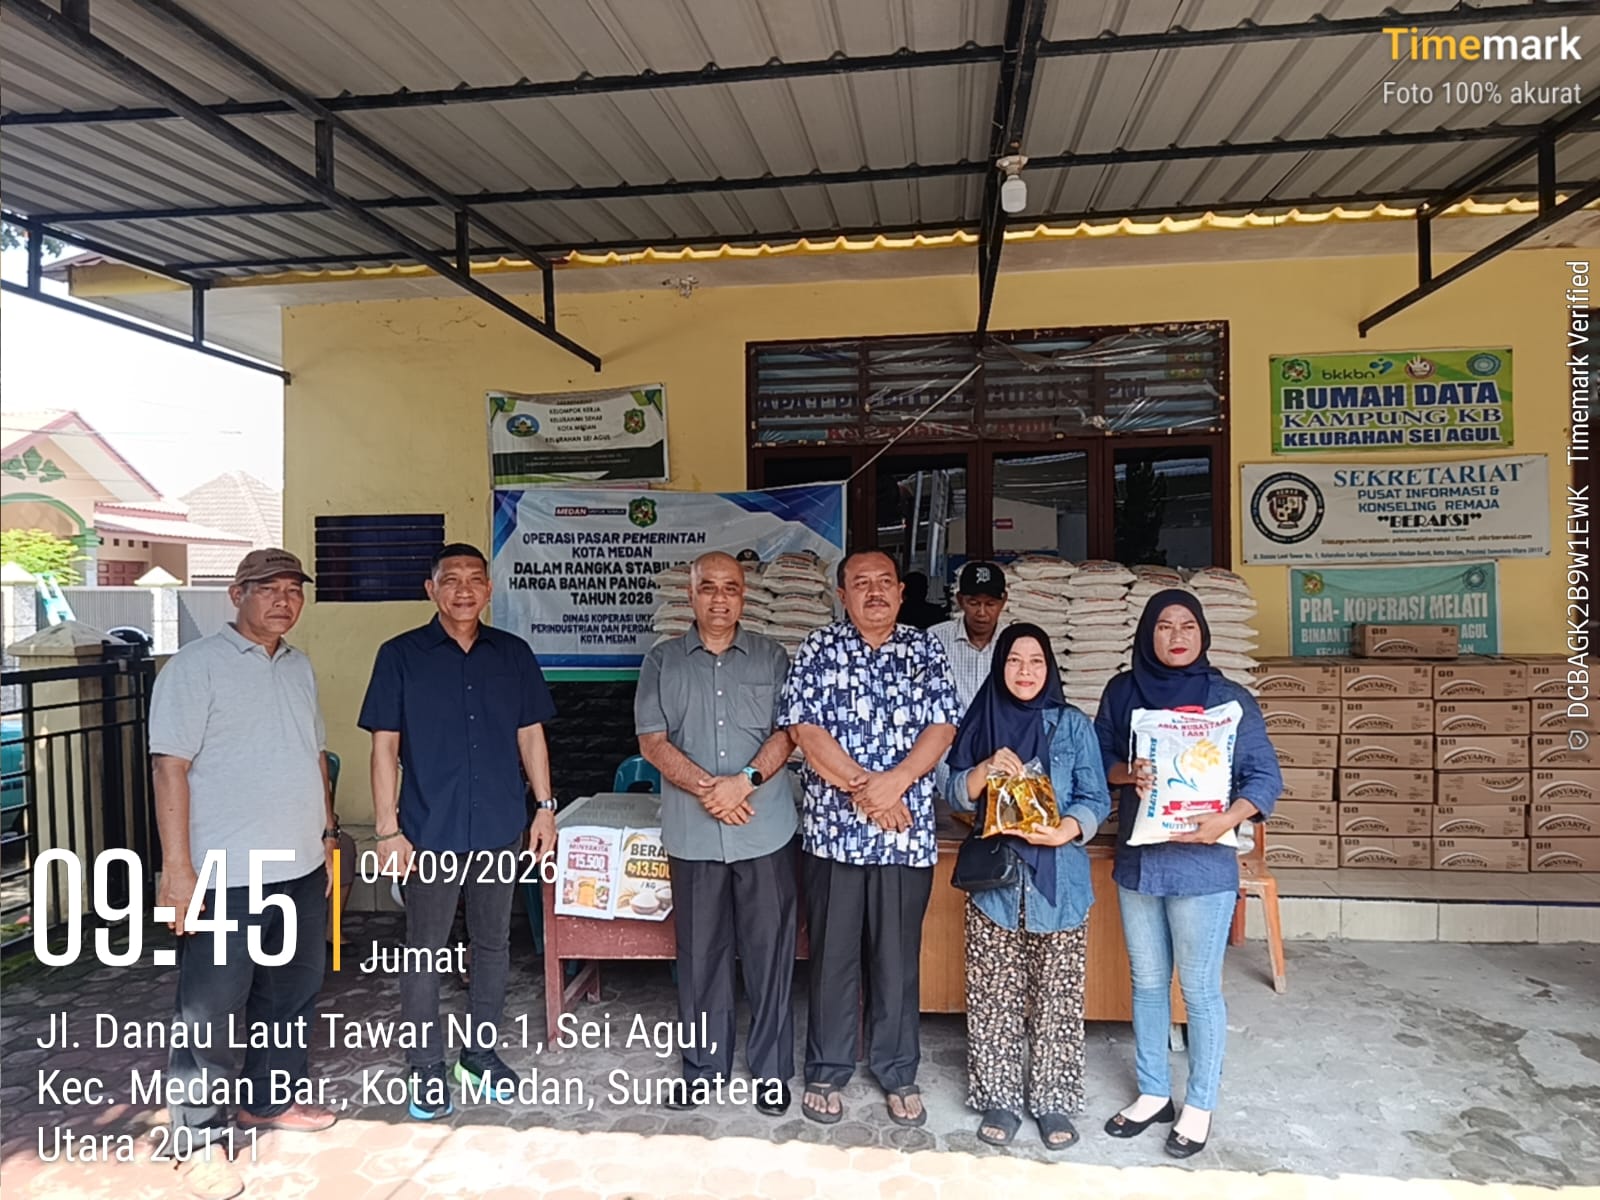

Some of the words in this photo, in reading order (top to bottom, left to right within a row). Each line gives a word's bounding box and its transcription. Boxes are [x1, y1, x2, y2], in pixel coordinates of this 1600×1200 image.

[1322, 369, 1375, 380] bkkbn
[1283, 385, 1405, 410] RUMAH
[1414, 382, 1499, 406] DATA
[1283, 410, 1447, 429] KAMPUNG
[1458, 408, 1502, 423] KB
[1284, 430, 1403, 447] KELURAHAN
[1409, 429, 1441, 443] SEI
[1446, 427, 1500, 442] AGUL
[1334, 463, 1523, 487] SEKRETARIAT
[1358, 488, 1402, 499] PUSAT
[1406, 486, 1486, 498] INFORMASI
[1490, 485, 1500, 495] &
[1359, 501, 1437, 512] KONSELING
[1445, 499, 1500, 510] REMAJA
[523, 533, 576, 545] OPERASI
[577, 533, 620, 544] PASAR
[622, 532, 706, 544] PEMERINTAH
[572, 547, 606, 558] KOTA
[608, 546, 653, 558] MEDAN
[514, 562, 562, 575] DALAM
[564, 562, 623, 575] RANGKA
[509, 577, 557, 590] HARGA
[560, 577, 607, 590] BAHAN
[609, 577, 661, 590] PANGA
[571, 592, 616, 606] TAHUN
[619, 592, 653, 606] 2026
[1300, 598, 1339, 623] PRA-
[1344, 595, 1426, 622] KOPERASI
[1429, 592, 1488, 618] MELATI
[562, 614, 590, 623] DINAS
[591, 614, 634, 623] KOPERASI
[531, 624, 600, 633] PERINDUSTRIAN
[601, 624, 620, 633] DAN
[1301, 627, 1341, 643] BINAAN
[1461, 623, 1489, 639] AGUL
[580, 634, 604, 644] KOTA
[605, 634, 636, 644] MEDAN
[630, 844, 669, 858] BERA
